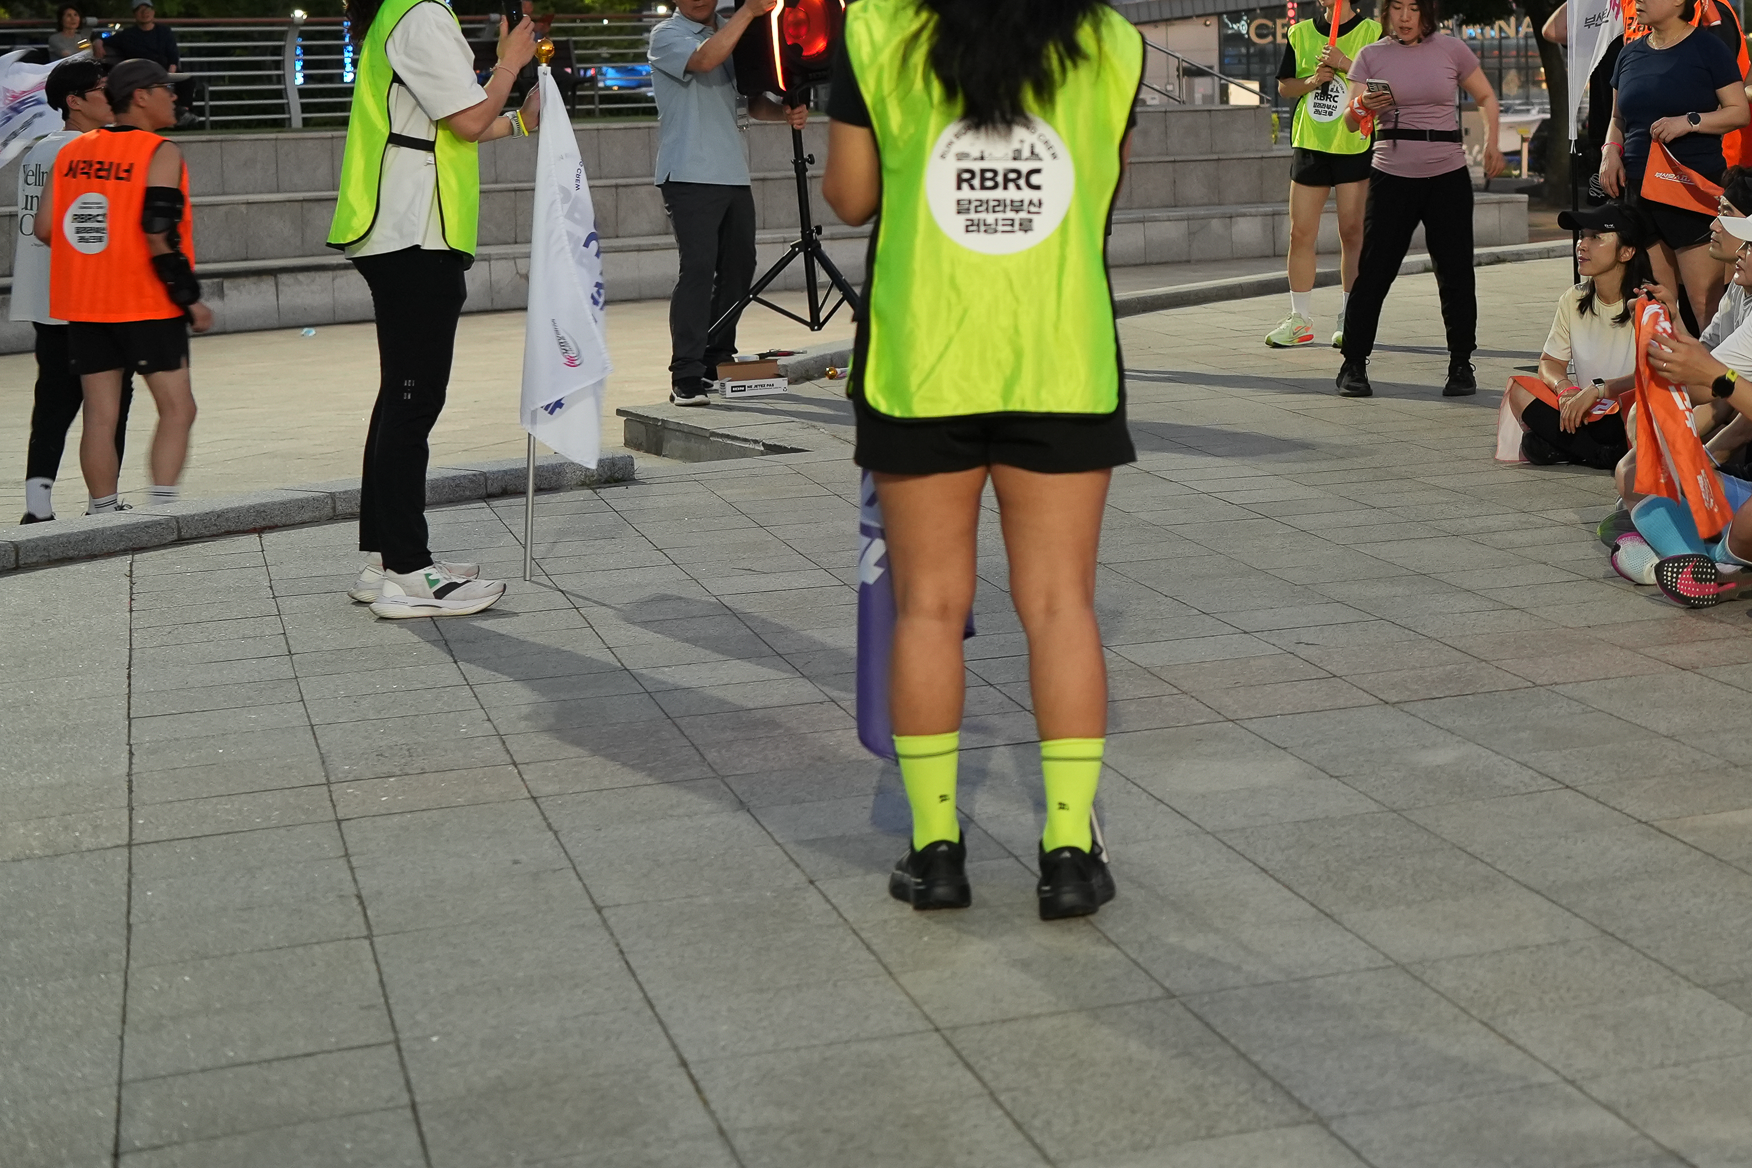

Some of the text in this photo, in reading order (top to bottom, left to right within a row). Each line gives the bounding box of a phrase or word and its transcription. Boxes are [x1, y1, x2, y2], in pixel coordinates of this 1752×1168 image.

[1314, 92, 1339, 103] RBRC
[956, 168, 1043, 191] RBRC
[956, 199, 1043, 215] 달려라부산
[965, 218, 1034, 234] 러닝크루
